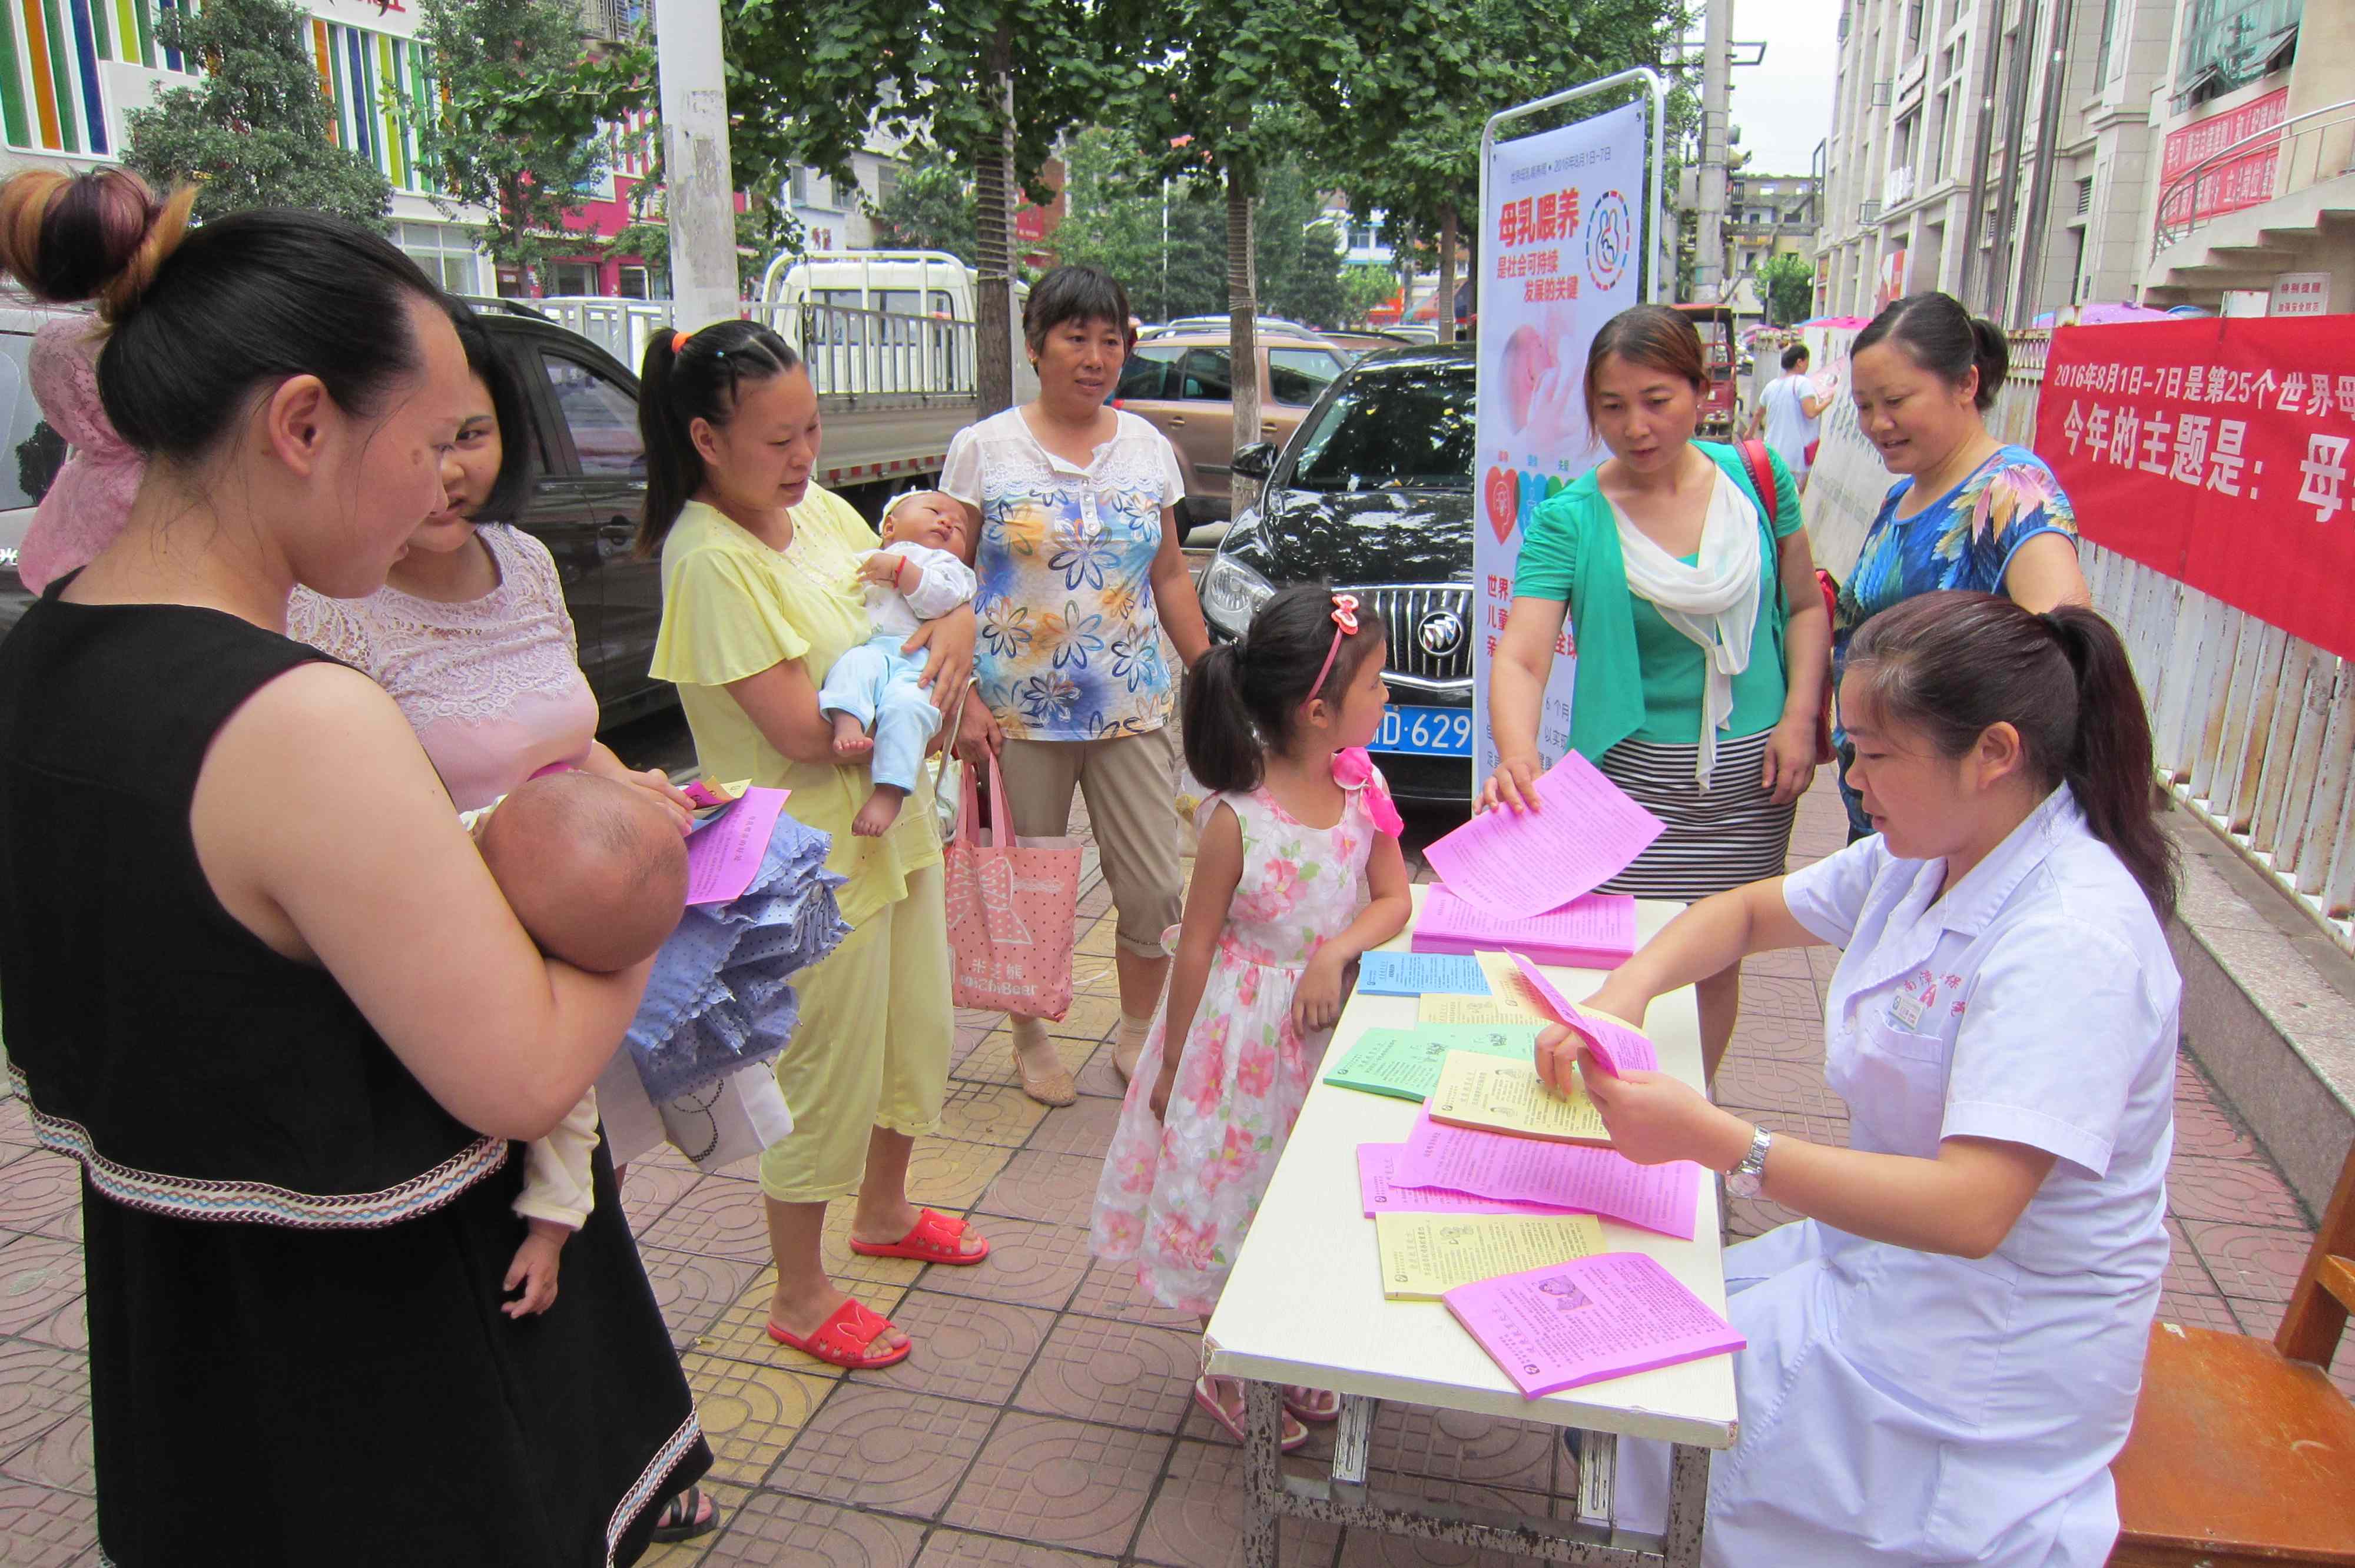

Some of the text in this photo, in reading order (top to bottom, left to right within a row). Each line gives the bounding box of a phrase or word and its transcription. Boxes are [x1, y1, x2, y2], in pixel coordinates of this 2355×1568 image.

[1498, 187, 1580, 248] 母乳喂养
[1497, 249, 1558, 279] 是社会可持续
[1524, 275, 1578, 303] 发展的关键
[2298, 433, 2355, 523] 母
[1488, 574, 1514, 603] 世界
[1372, 712, 1471, 749] D·629
